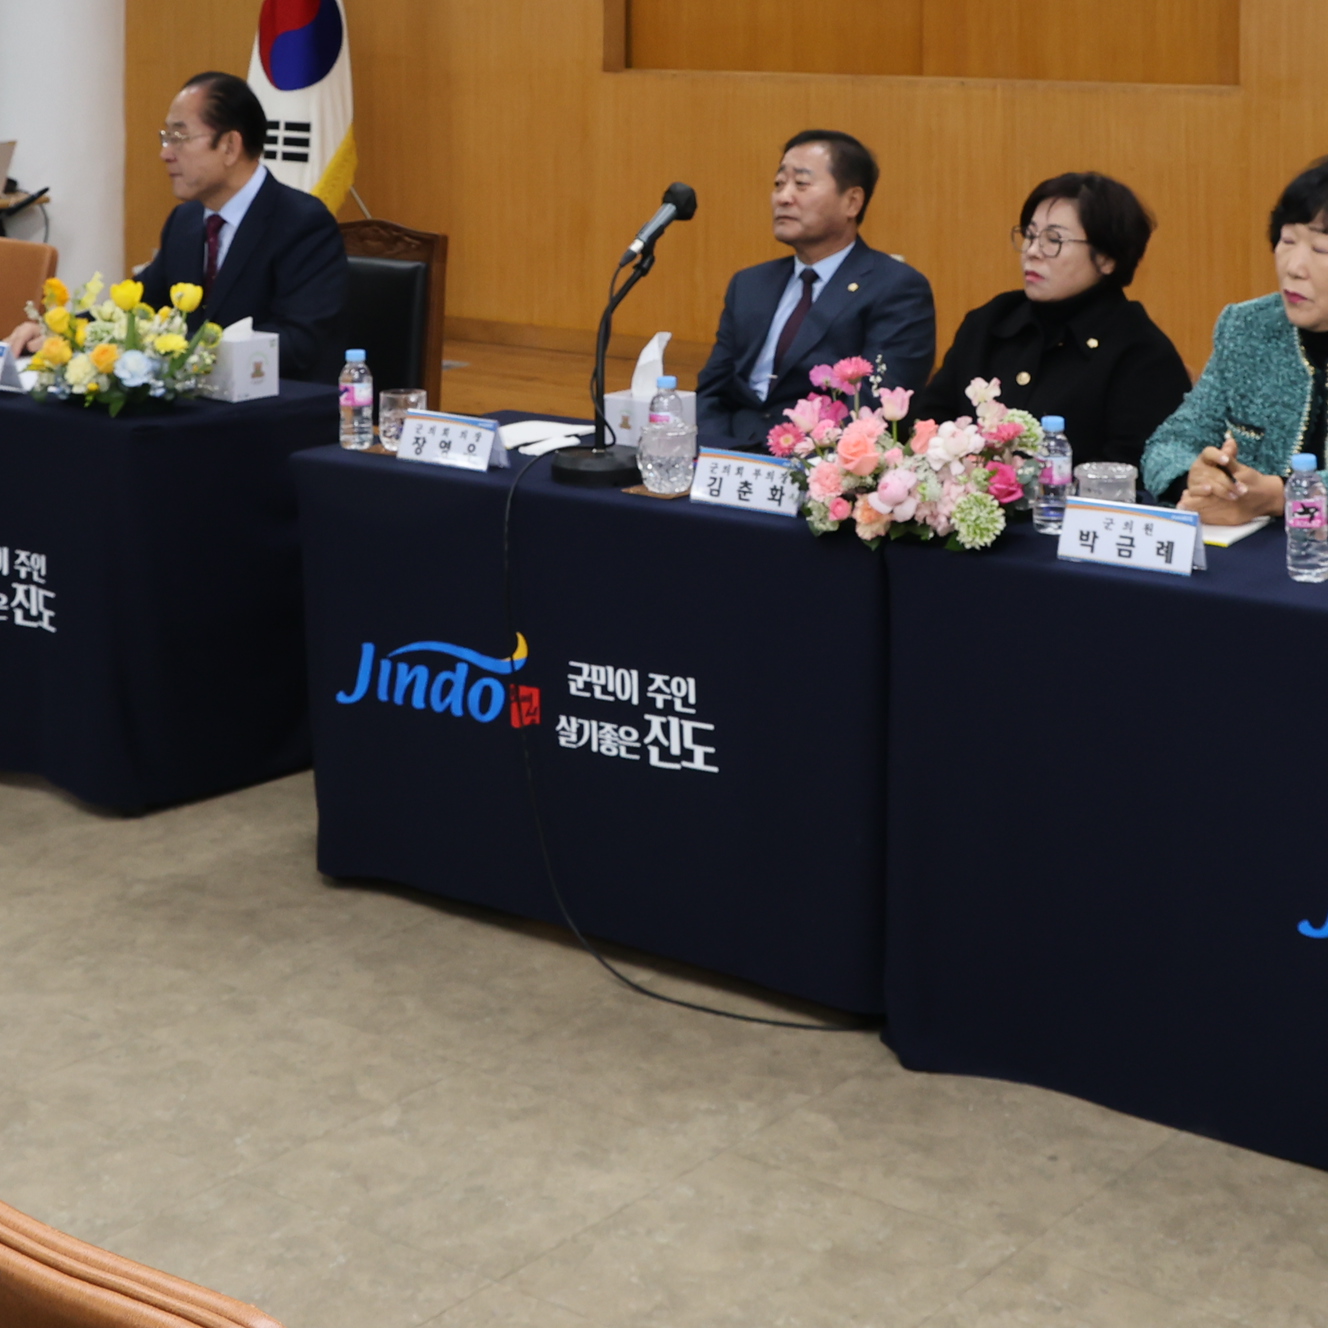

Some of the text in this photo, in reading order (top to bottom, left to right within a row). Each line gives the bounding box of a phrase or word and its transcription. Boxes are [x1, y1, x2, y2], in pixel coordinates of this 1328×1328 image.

[707, 476, 785, 507] 김춘화
[14, 548, 47, 583] 주인
[1078, 529, 1175, 565] 박금례
[10, 582, 57, 633] 진도
[336, 642, 505, 723] Jindo
[567, 660, 639, 706] 군민이
[647, 672, 697, 715] 주인
[555, 713, 719, 774] 살기좋은 진도
